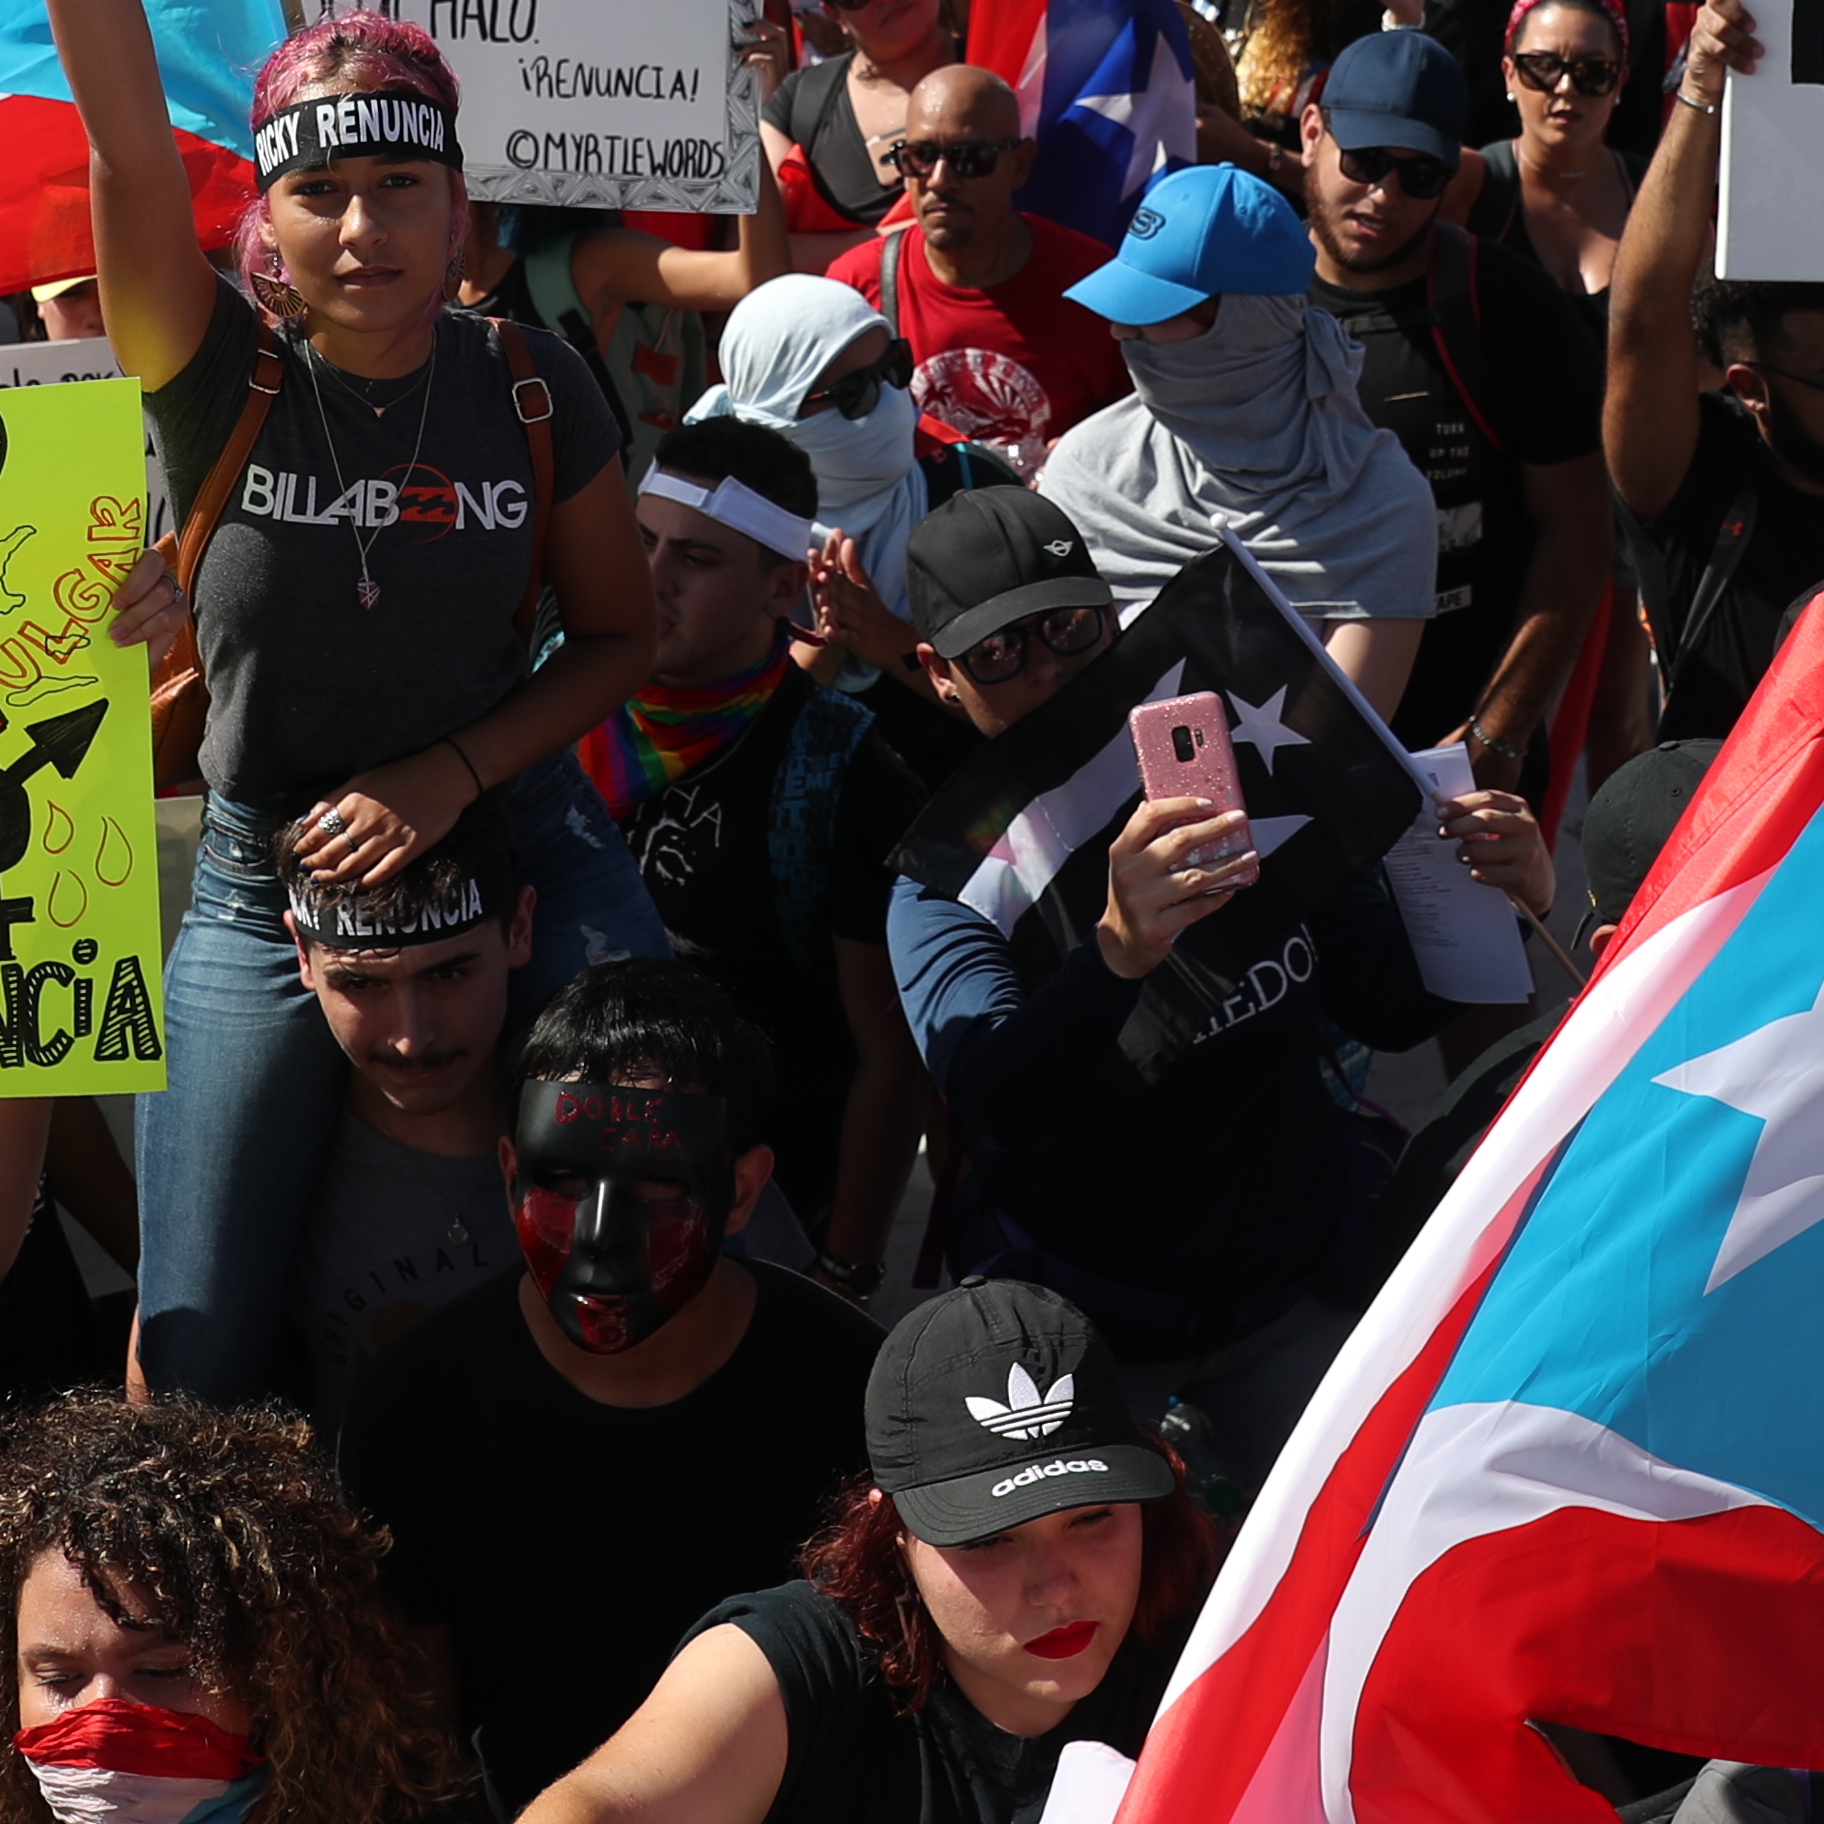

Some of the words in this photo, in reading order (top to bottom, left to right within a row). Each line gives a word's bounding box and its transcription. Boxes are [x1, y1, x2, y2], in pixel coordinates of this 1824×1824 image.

[517, 55, 701, 104] ¡RENUNCIA!
[253, 112, 303, 178] RICKY
[315, 97, 447, 154] RENUNCIA
[323, 1241, 489, 1367] ORIGINAL
[990, 1457, 1110, 1499] adidas
